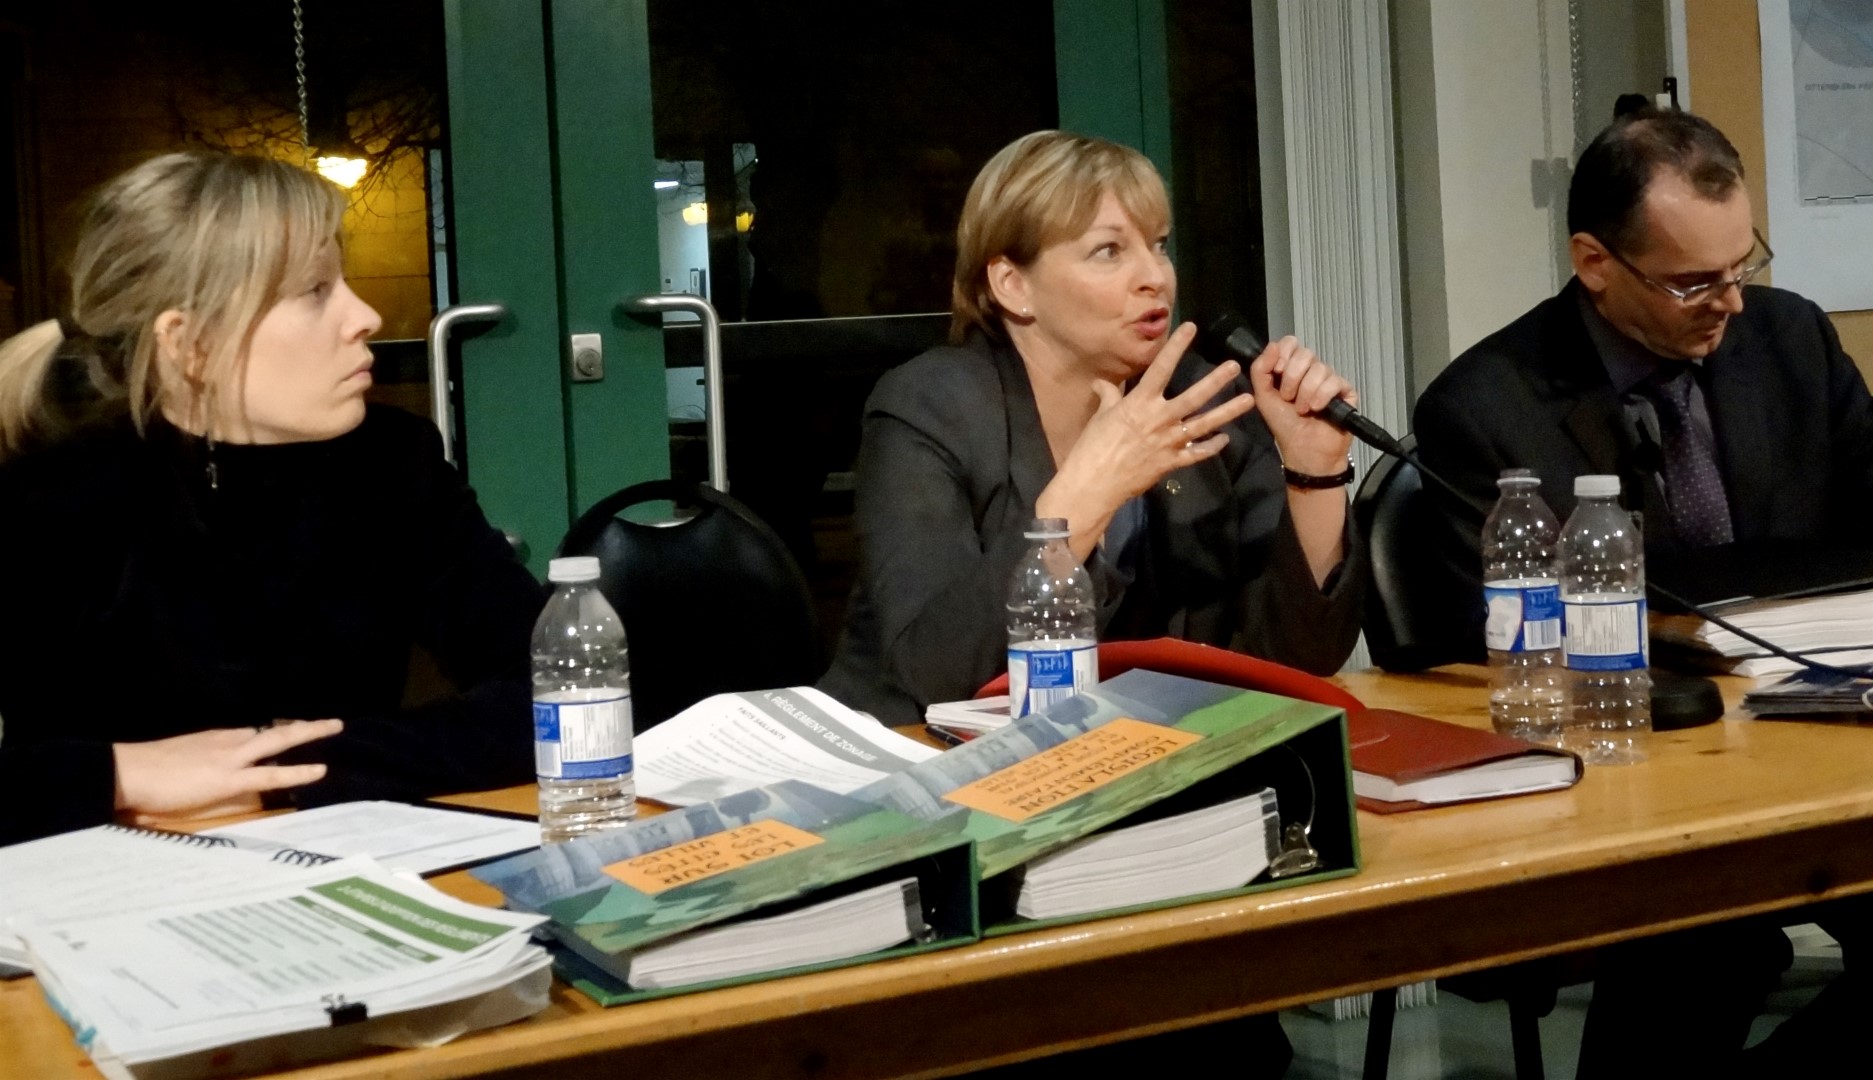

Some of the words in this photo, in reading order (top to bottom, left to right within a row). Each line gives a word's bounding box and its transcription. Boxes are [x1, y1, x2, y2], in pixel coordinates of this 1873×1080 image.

[771, 696, 827, 735] RÈGLEMENT
[823, 731, 840, 743] DE
[836, 739, 878, 762] ZONAGE
[729, 827, 761, 839] ET
[730, 833, 779, 849] LES
[628, 840, 715, 868] VILLES
[738, 840, 796, 861] LOI
[661, 862, 729, 884] SUR
